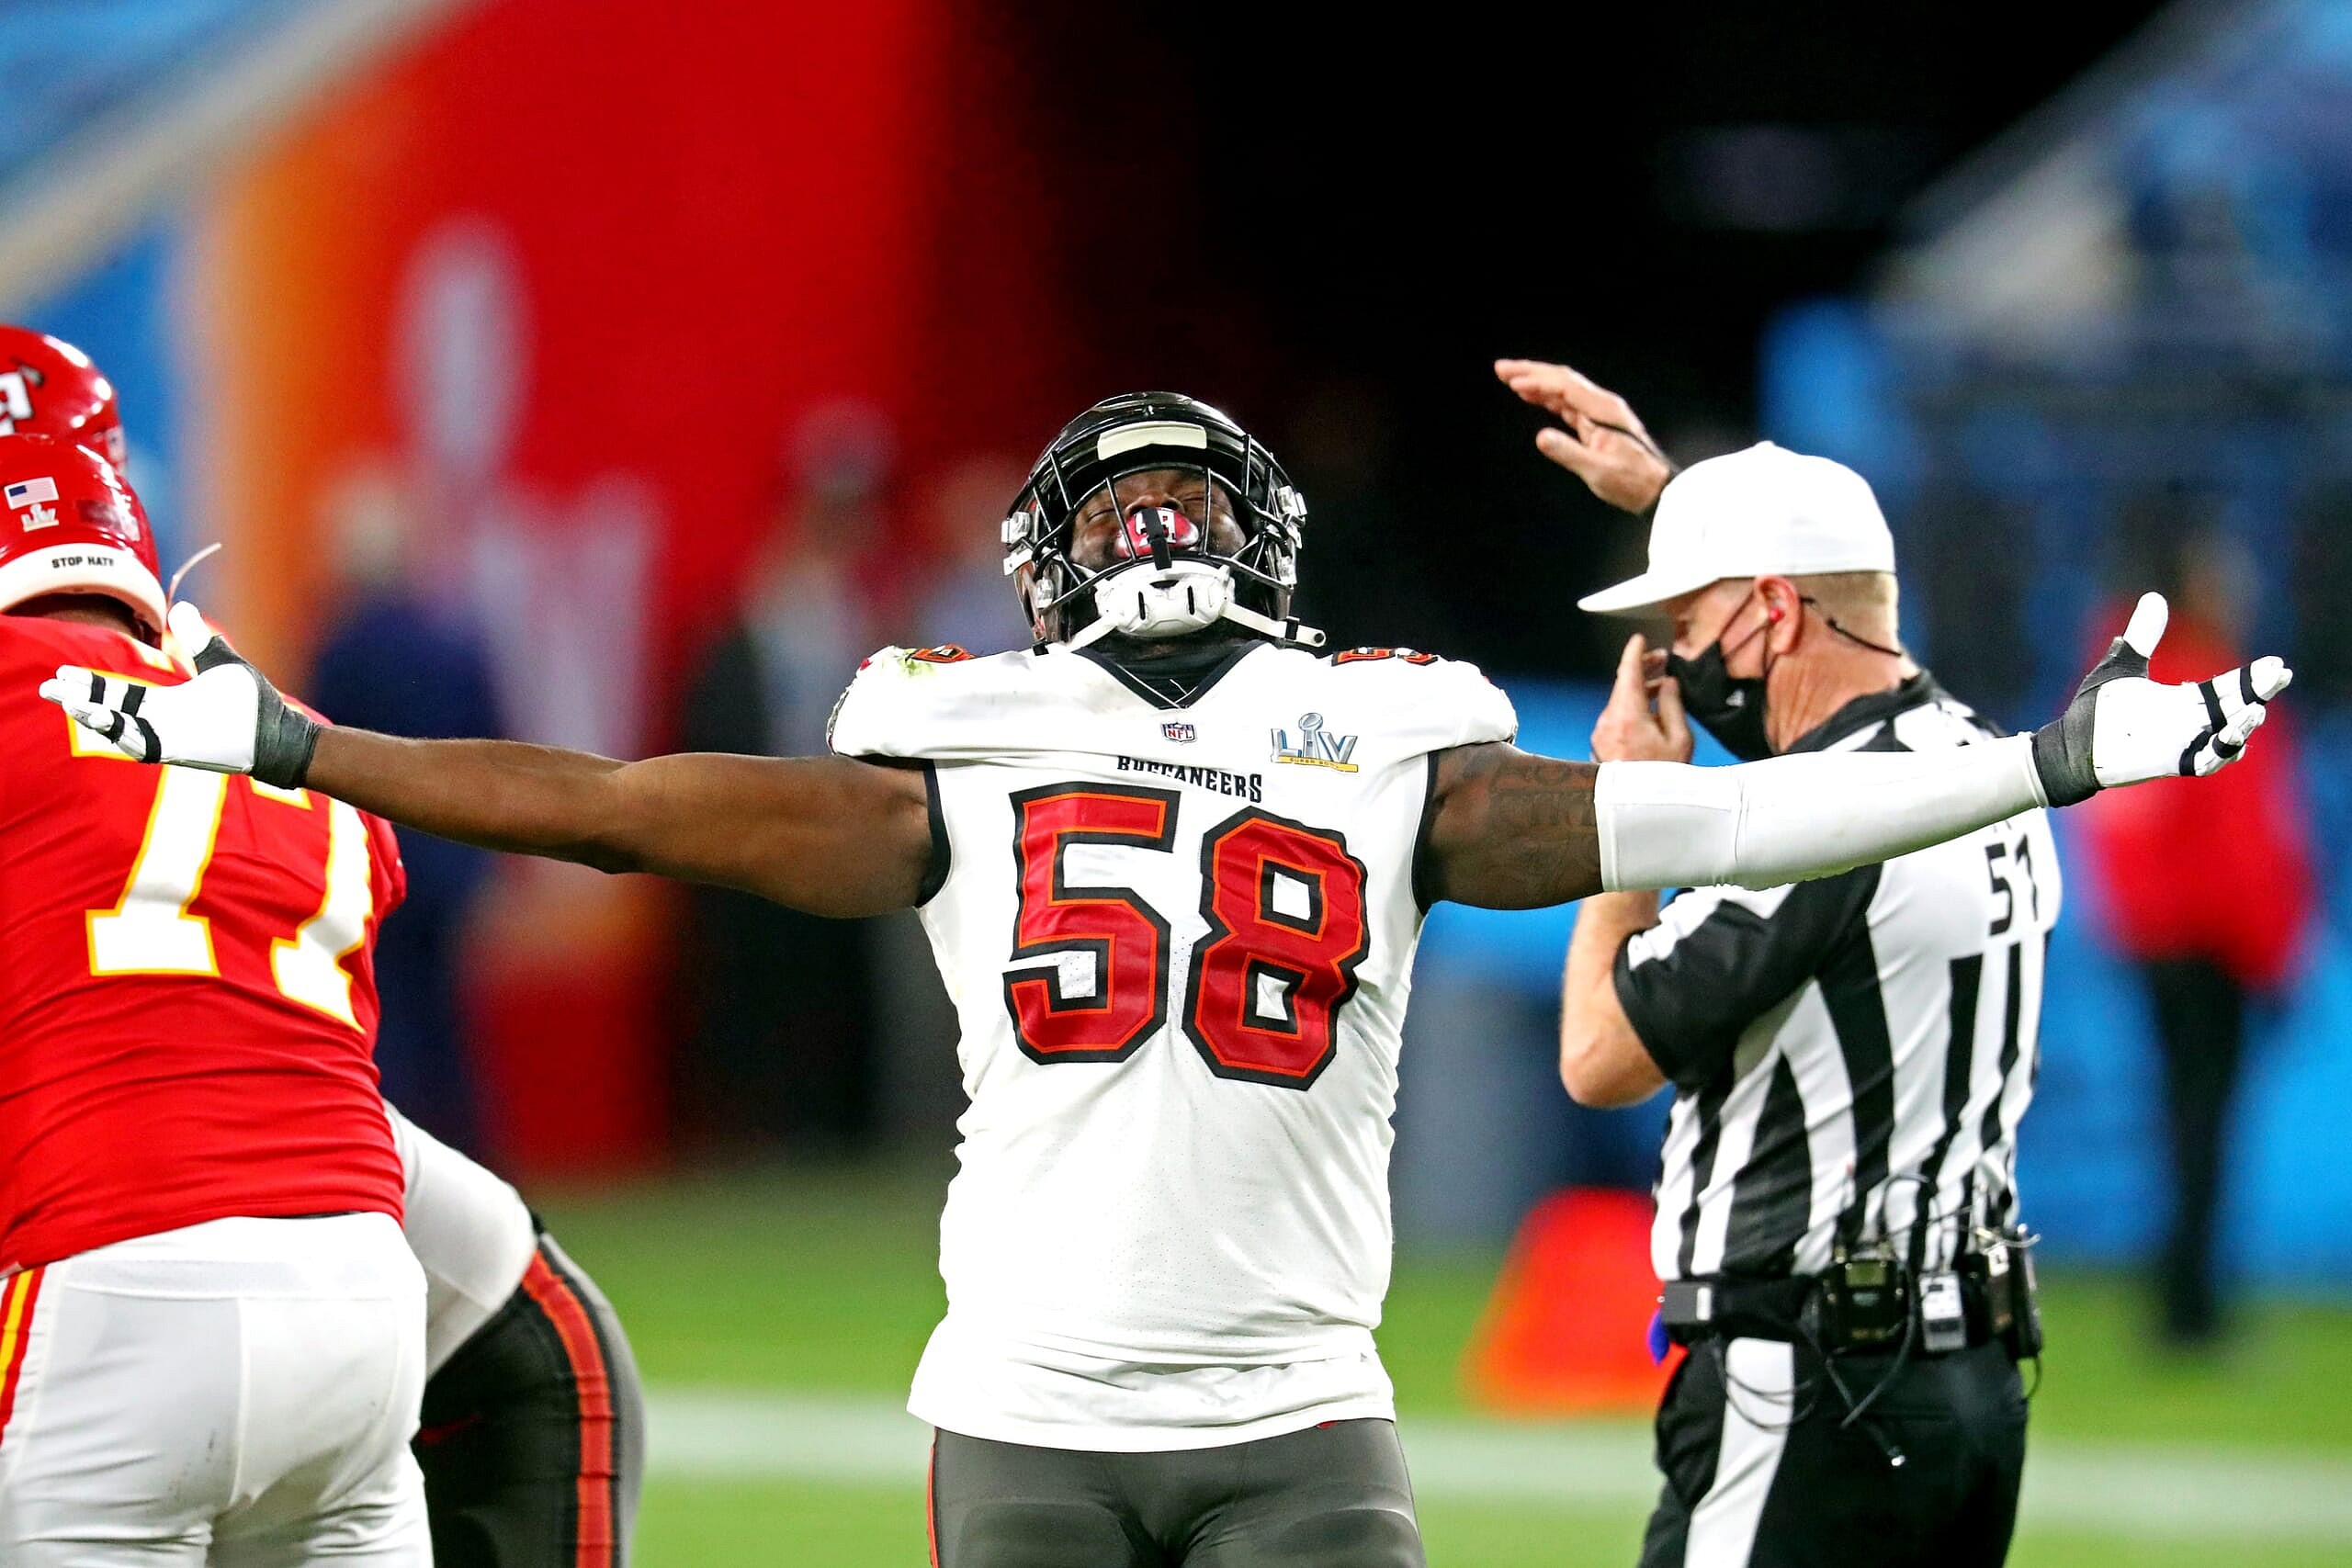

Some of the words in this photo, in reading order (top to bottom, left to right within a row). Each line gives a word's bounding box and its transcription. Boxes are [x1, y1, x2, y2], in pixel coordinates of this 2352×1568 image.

[51, 556, 83, 569] STOP
[1167, 728, 1193, 739] NFL
[1117, 755, 1262, 804] BUCCANEERS
[67, 668, 372, 1034] 77
[1984, 832, 2038, 937] 51
[1002, 781, 1370, 1091] 58
